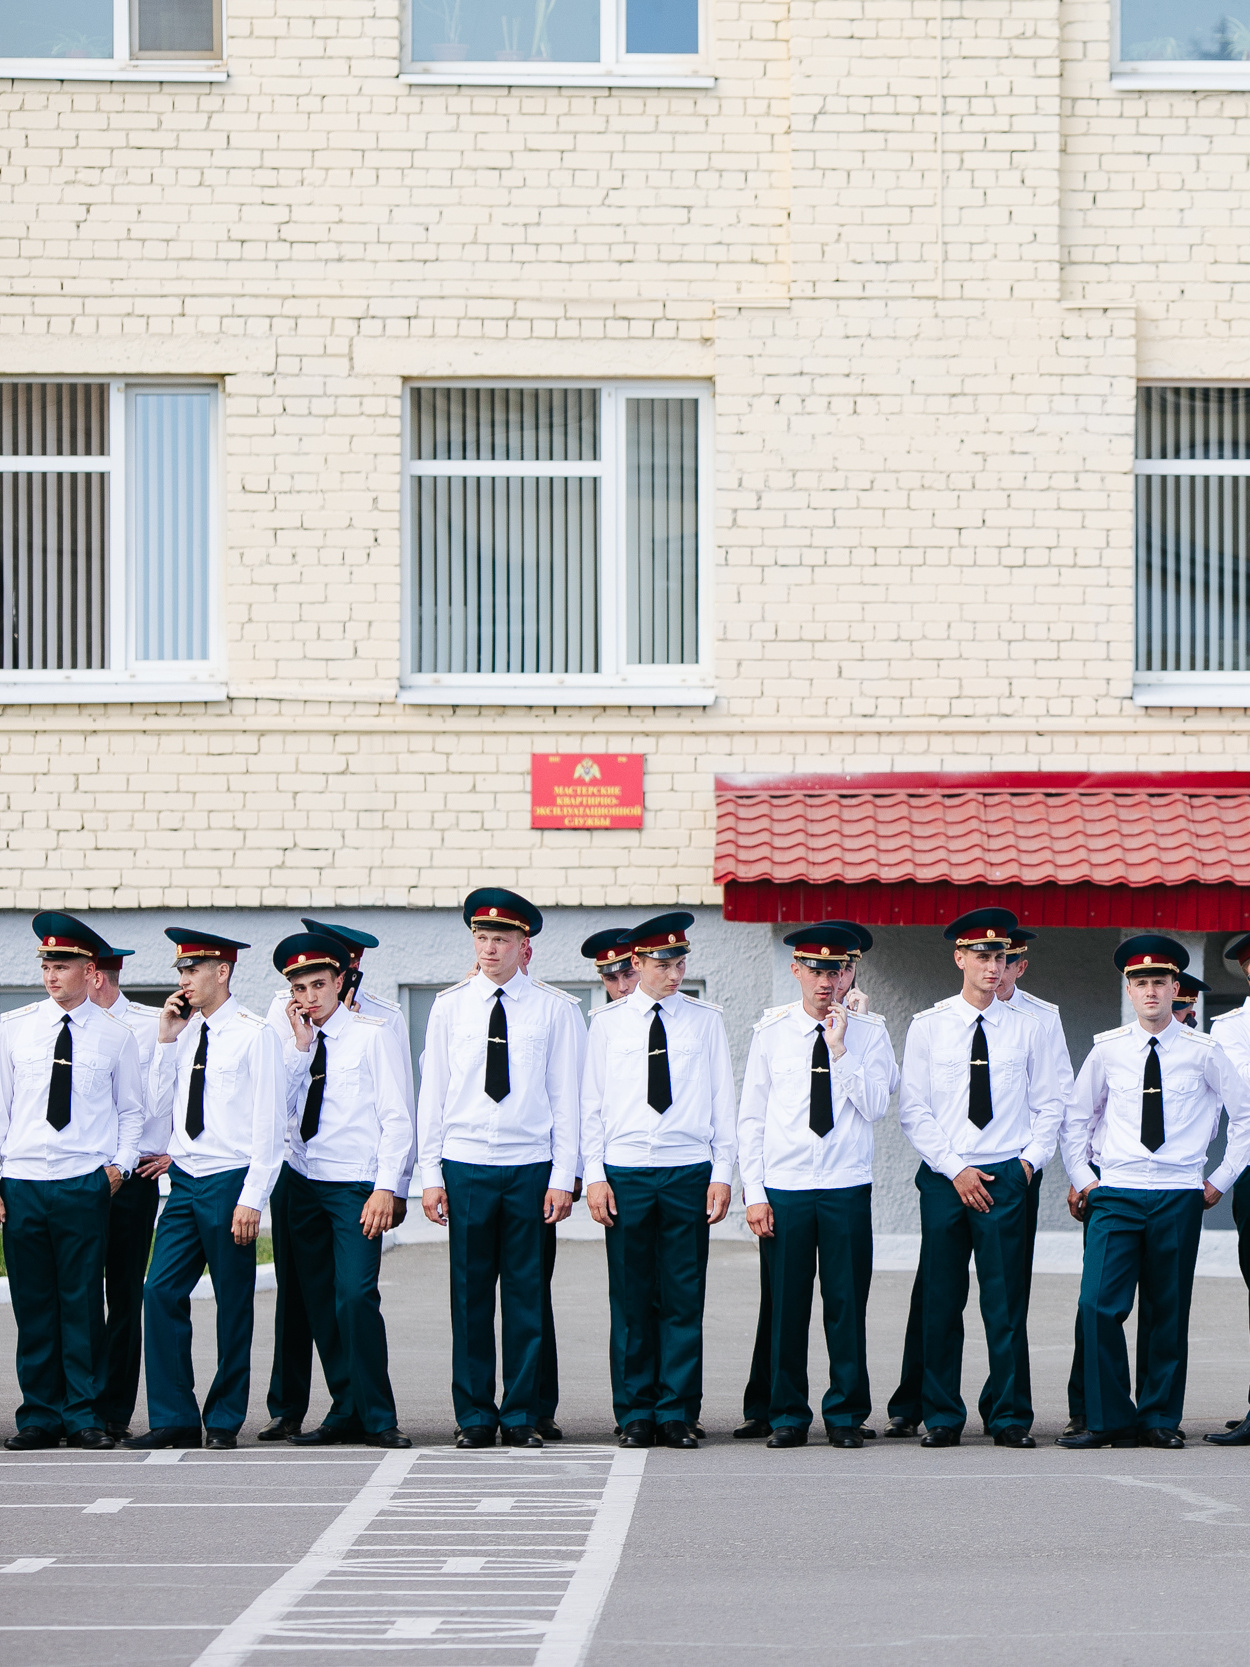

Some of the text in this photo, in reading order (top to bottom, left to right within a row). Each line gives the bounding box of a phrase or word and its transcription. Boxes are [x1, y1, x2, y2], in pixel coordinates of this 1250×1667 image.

[553, 786, 621, 795] МАСТЕРСКИЕ
[556, 796, 619, 805] КВАРТИРНО-
[564, 817, 611, 826] СЛУЖБЫ
